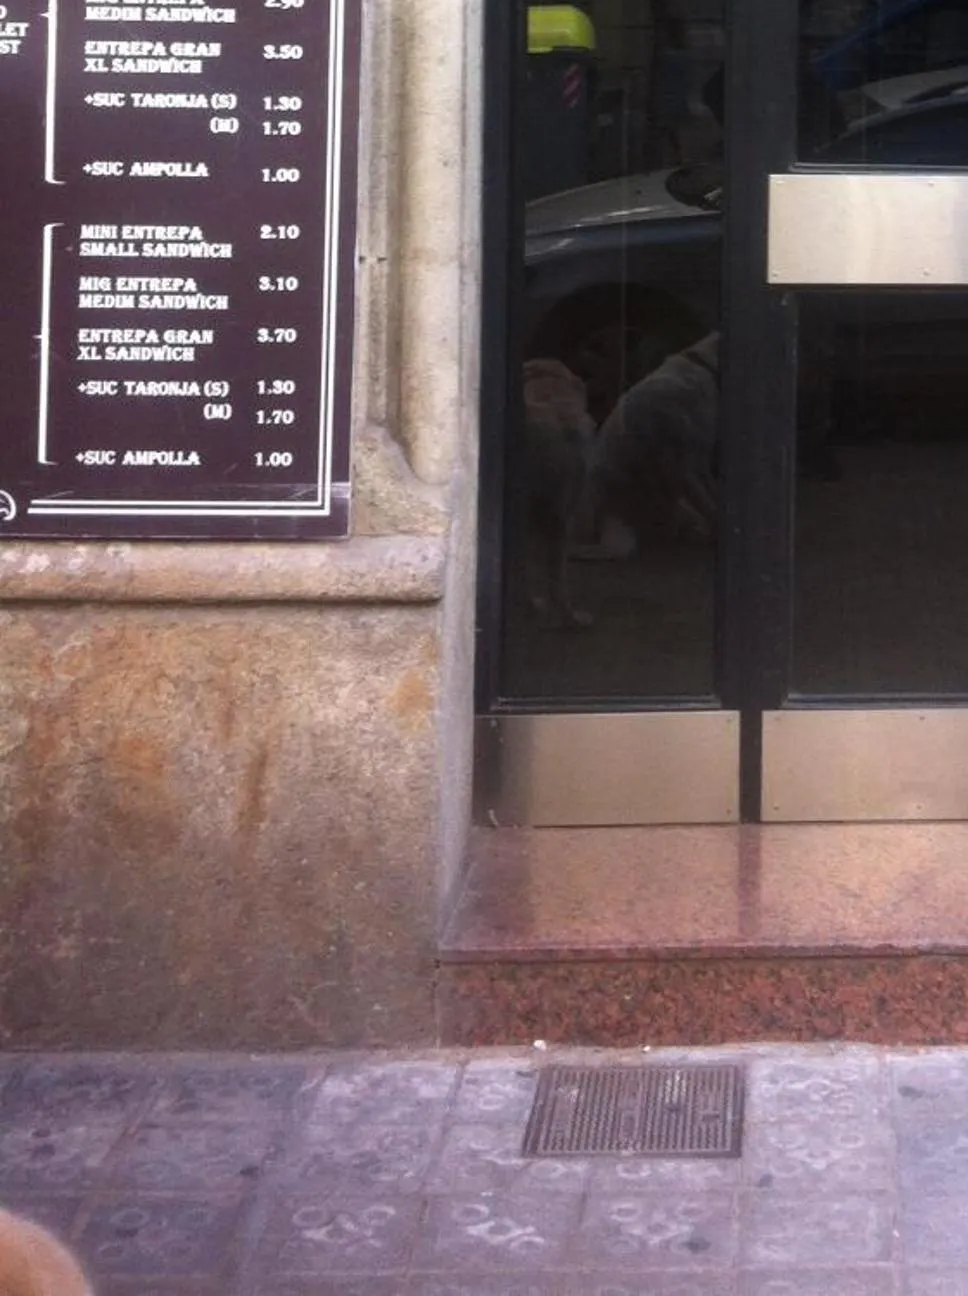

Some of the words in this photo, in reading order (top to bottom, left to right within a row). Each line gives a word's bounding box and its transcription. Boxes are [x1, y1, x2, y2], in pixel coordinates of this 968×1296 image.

[145, 6, 235, 22] SANDWICH
[84, 41, 167, 56] ENTREPA
[167, 42, 221, 57] GRAN
[264, 45, 303, 59] 3.50
[84, 58, 109, 72] XL
[111, 57, 202, 73] SANDWICH
[131, 93, 208, 108] TARONJA
[211, 93, 237, 109] (S)
[264, 96, 302, 110] 1.30
[263, 121, 301, 135] 1.70
[130, 162, 208, 177] AMPOLLA
[262, 168, 299, 182] 1.00
[80, 225, 117, 239] MINI
[122, 225, 203, 240] ENTREPA
[261, 225, 299, 239] 2.10
[80, 242, 139, 256] SMALL
[142, 242, 232, 257] SANDWICH
[79, 277, 111, 291] MIG
[116, 277, 197, 292] ENTREPA
[259, 276, 298, 290] 3.10
[138, 293, 228, 309] SANDWICH
[78, 329, 159, 344] ENTREPA
[163, 330, 213, 344] GRAN
[258, 328, 296, 342] 3.70
[77, 346, 102, 360] XL
[105, 344, 194, 361] SANDWICH
[124, 381, 200, 396] TARONJA
[204, 381, 229, 397] (S)
[258, 380, 295, 394] 1.30
[257, 410, 294, 424] 1.70
[122, 451, 200, 465] AMPOLLA
[255, 452, 292, 466] 1.00
